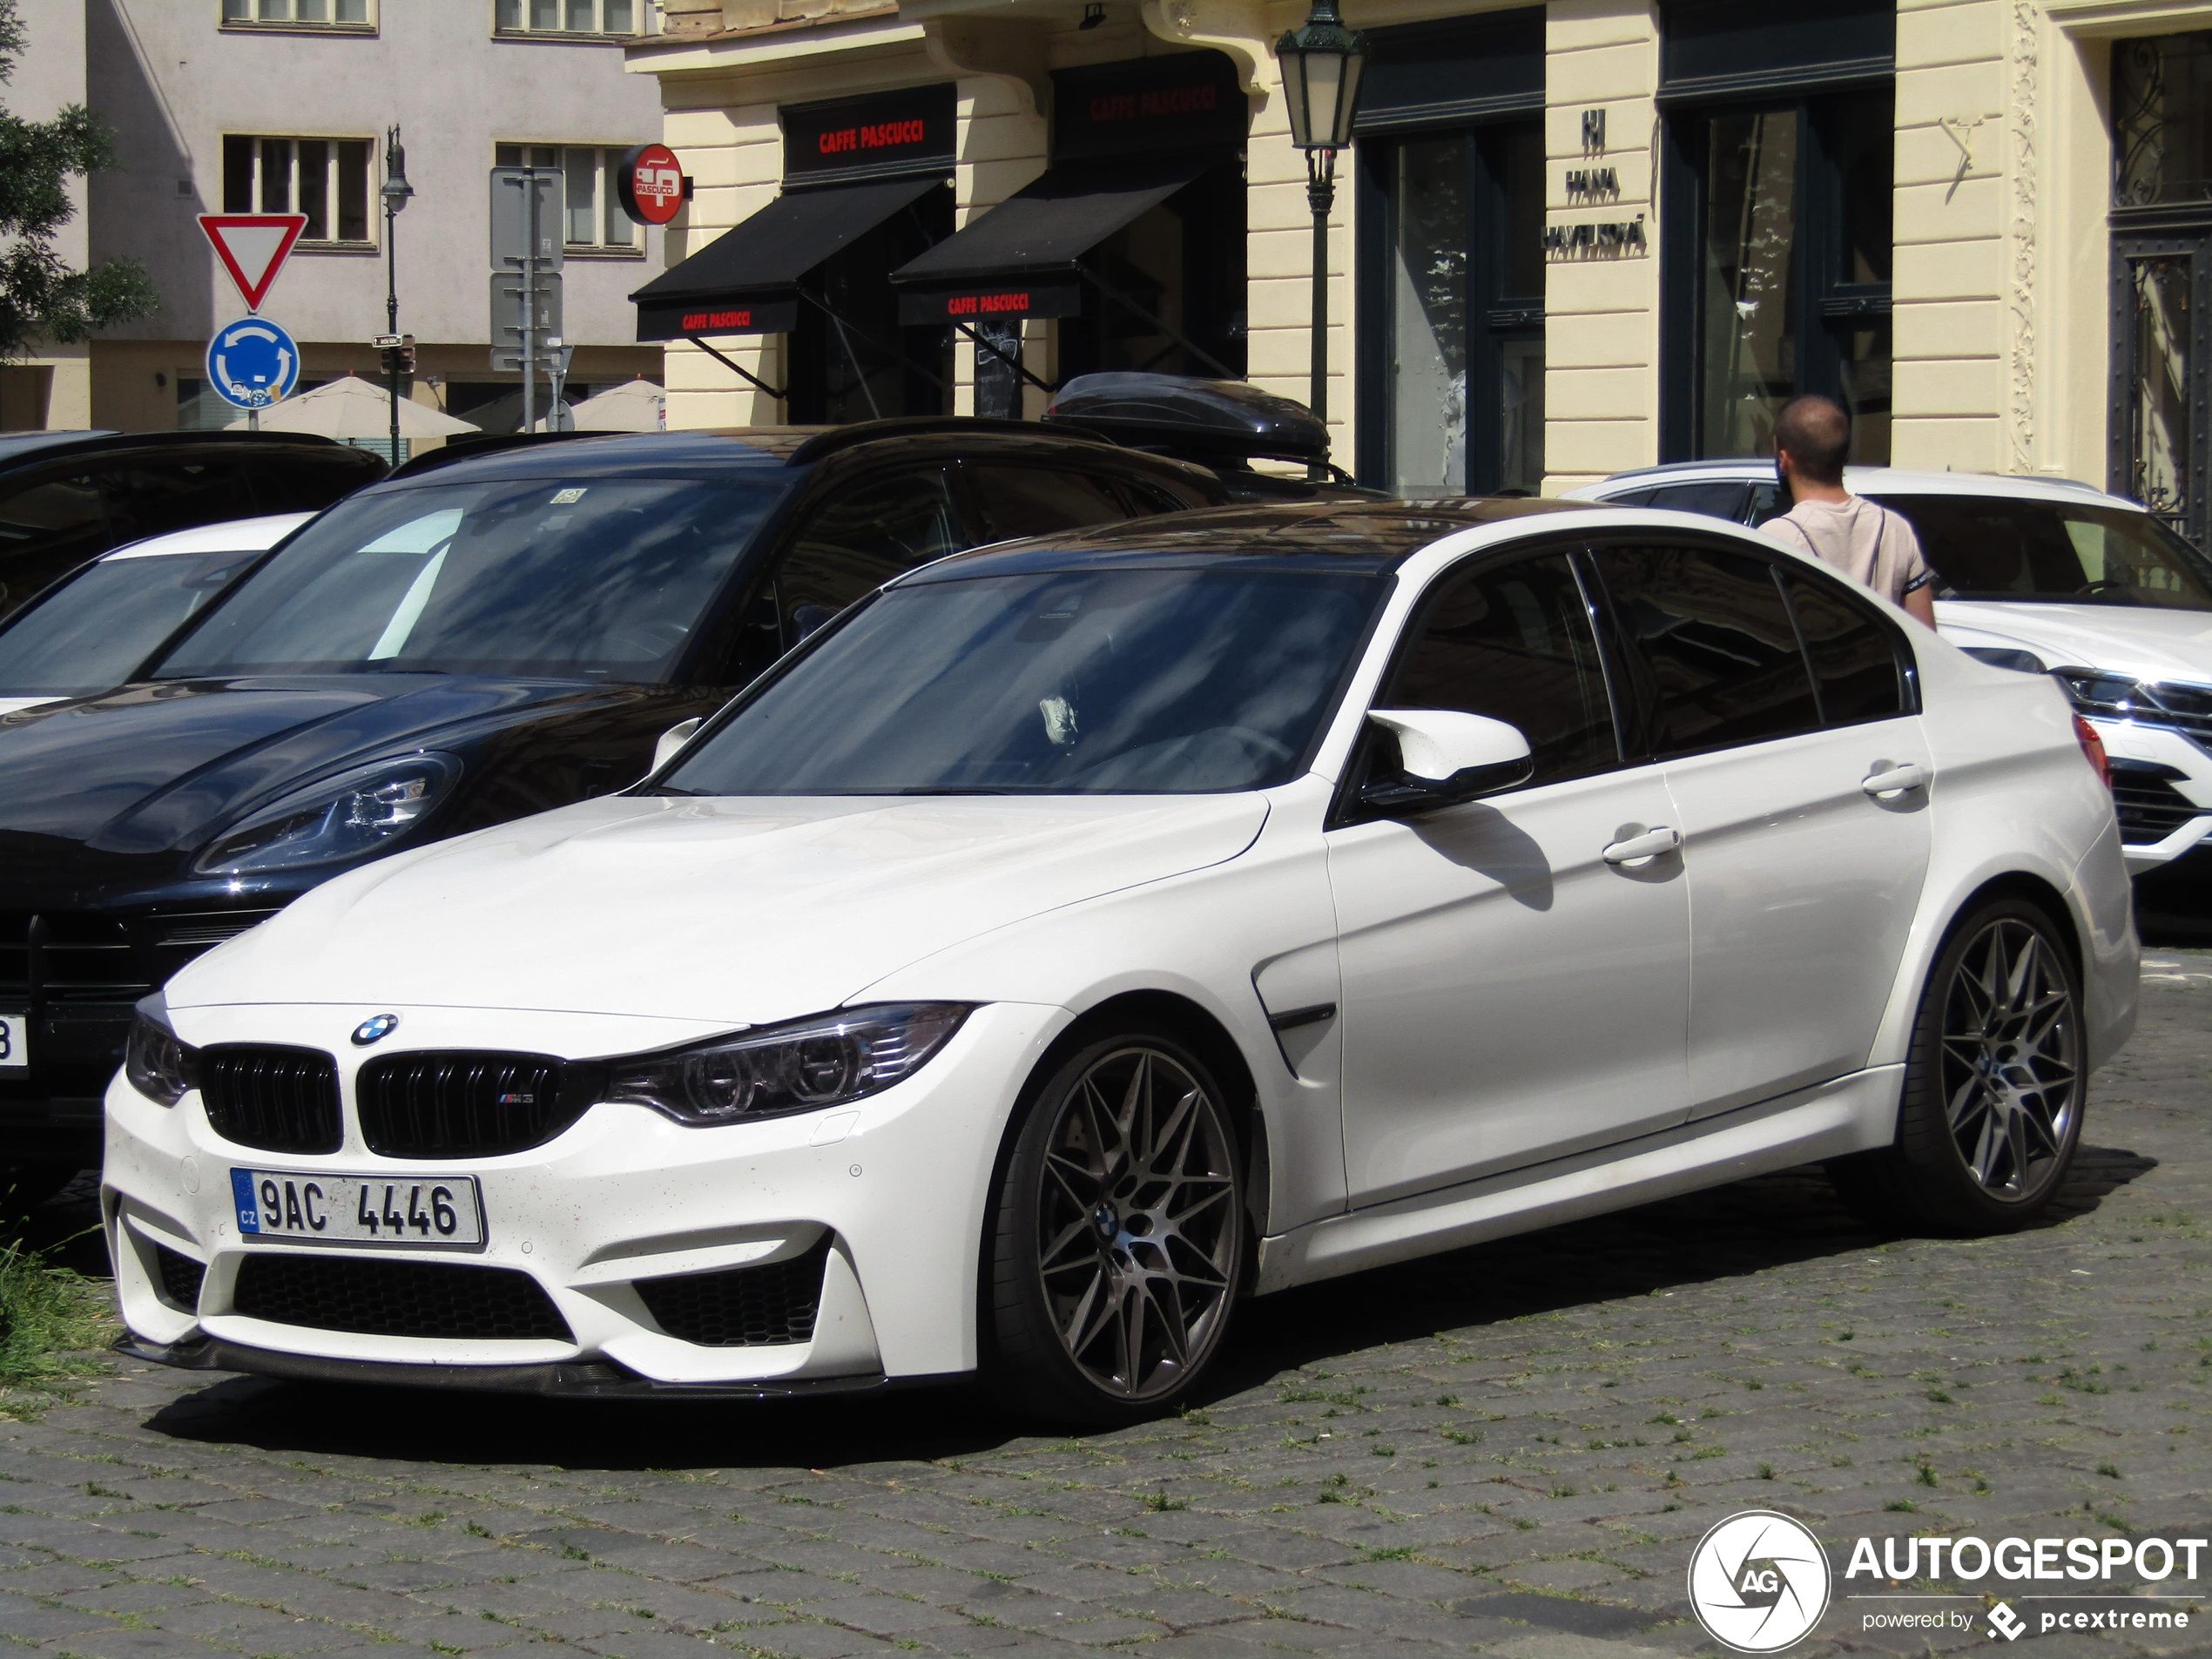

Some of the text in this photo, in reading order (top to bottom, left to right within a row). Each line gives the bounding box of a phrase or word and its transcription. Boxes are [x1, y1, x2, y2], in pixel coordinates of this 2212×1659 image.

[819, 119, 923, 153] CAFFE PASCUCCI
[637, 185, 674, 195] PASCUCCI
[1565, 167, 1621, 193] HANA
[948, 293, 1029, 314] CAFFE PASCUCCI
[683, 311, 751, 329] CAFFE PASCUCCI
[261, 1178, 457, 1235] 9AC 4446
[240, 1210, 257, 1225] CZ
